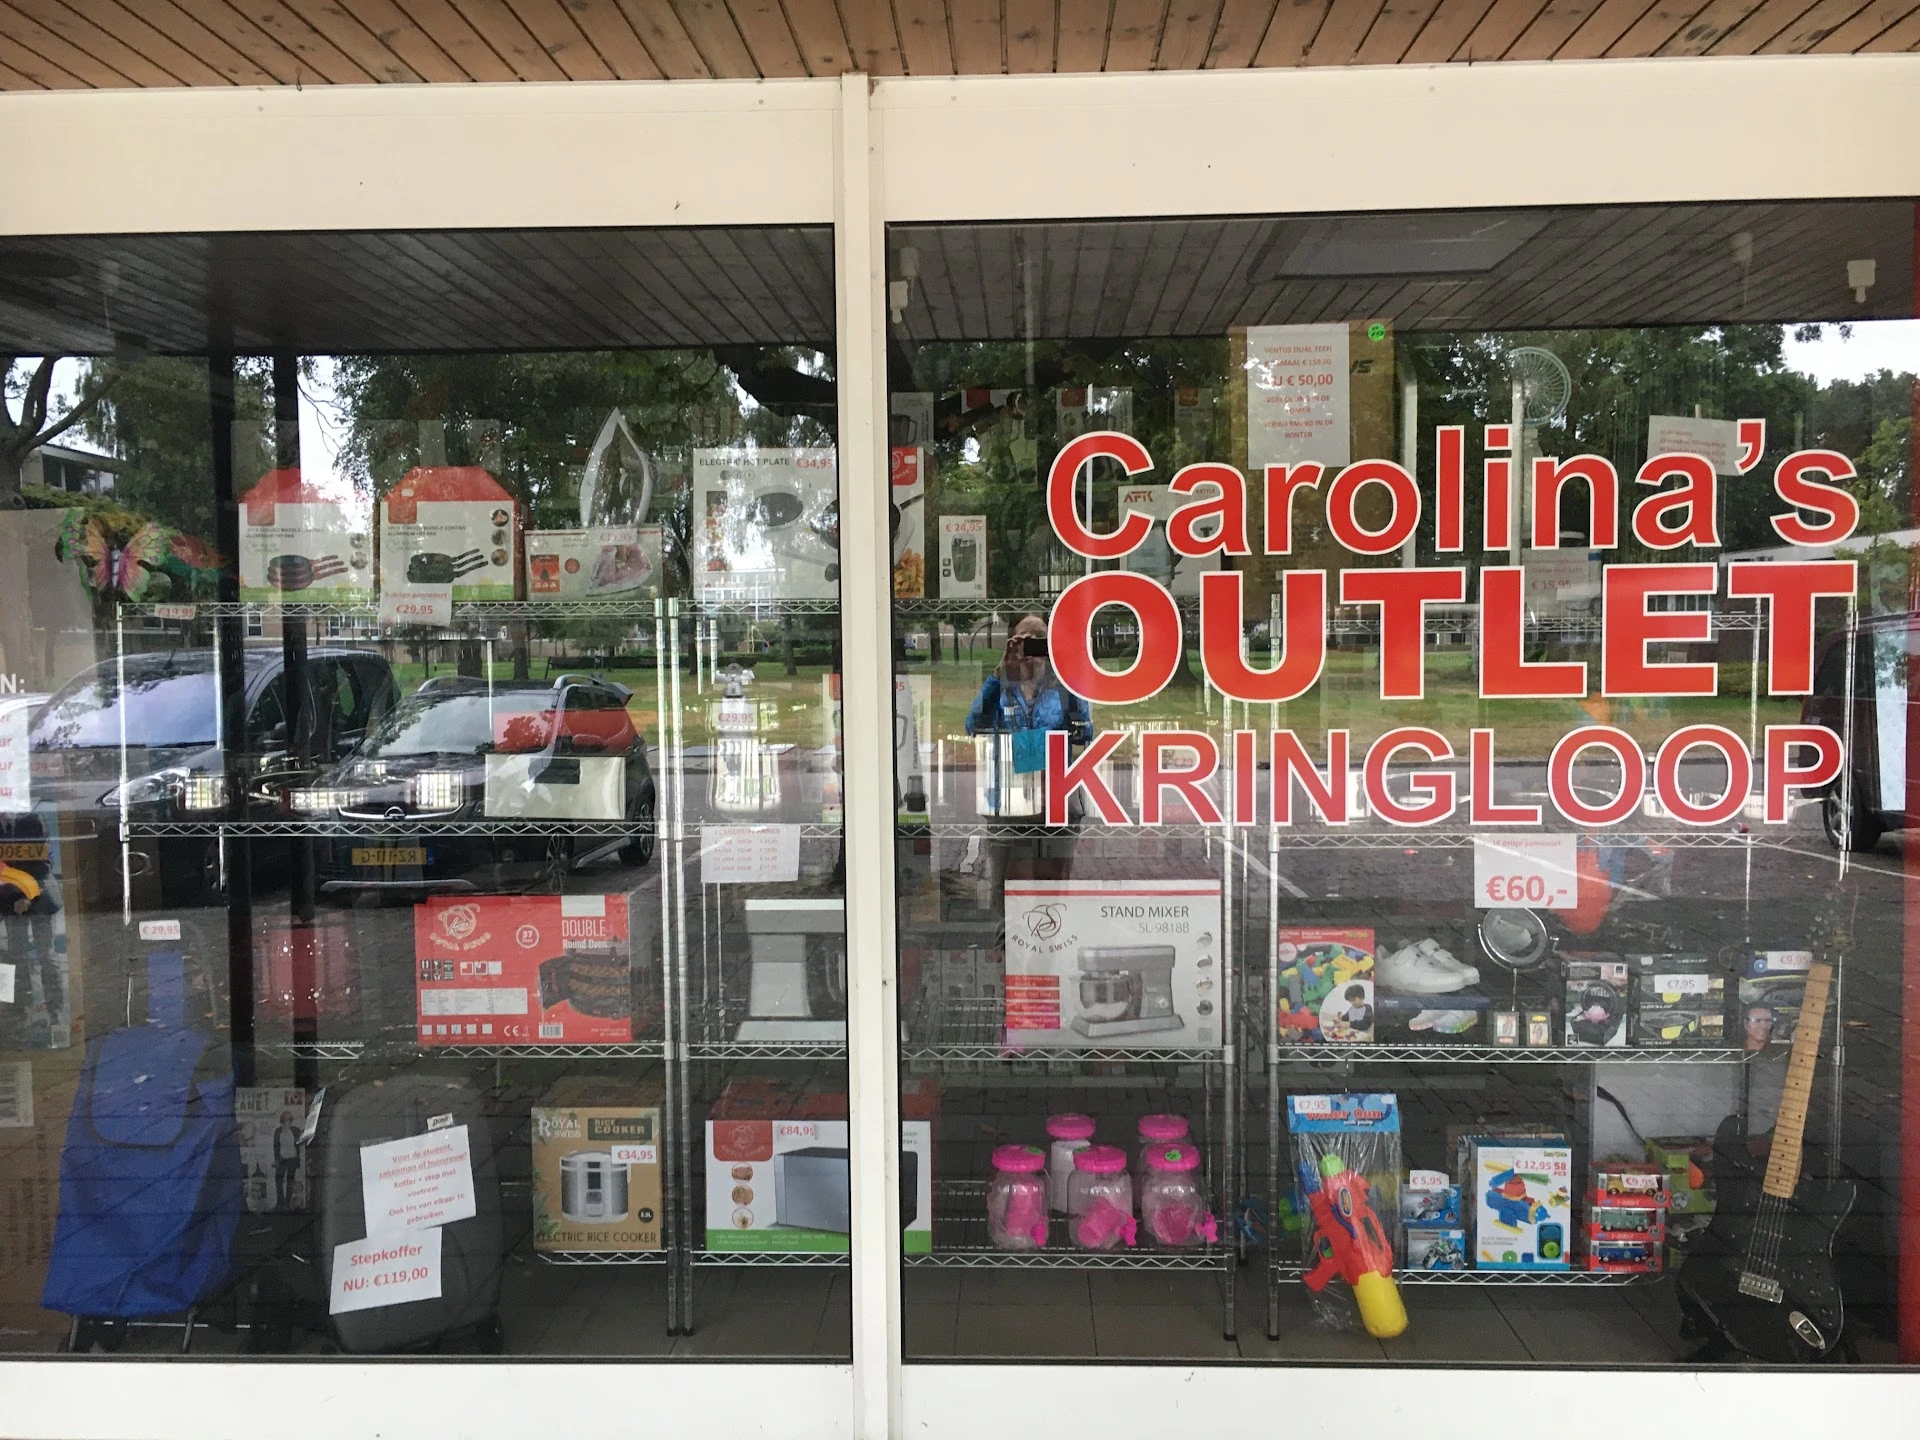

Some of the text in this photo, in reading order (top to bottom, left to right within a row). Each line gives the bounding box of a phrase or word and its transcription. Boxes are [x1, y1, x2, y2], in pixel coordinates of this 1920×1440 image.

[1287, 376, 1294, 386] €
[1299, 374, 1333, 387] 50,00
[946, 523, 981, 533] € 24,95
[1542, 580, 1572, 590] 19,95
[396, 605, 433, 615] €29,95
[1047, 561, 1859, 705] OUTLET
[717, 713, 754, 724] €29,95
[1044, 724, 1845, 828] KRINGLOOP
[1101, 906, 1189, 917] STAND MIXER
[152, 925, 178, 935] 29,95
[562, 920, 606, 937] DOUBLE
[1139, 923, 1189, 933] SL-9818B
[563, 939, 586, 949] Round
[1011, 934, 1078, 953] ROYAL SWISS
[1668, 980, 1695, 989] €7,95
[1299, 1102, 1325, 1110] €7,95
[1353, 1108, 1383, 1119] Gun
[595, 1126, 644, 1134] COOKER
[781, 1126, 815, 1136] €84,95
[413, 1150, 420, 1158] de
[618, 1150, 652, 1160] €34,95
[419, 1161, 426, 1169] of
[1515, 1160, 1551, 1170] € 12,95
[1554, 1162, 1566, 1170] 58
[394, 1179, 416, 1188] Koffer
[425, 1173, 440, 1181] step
[1412, 1177, 1442, 1186] € 5,95
[408, 1186, 438, 1197] voetrem
[587, 1233, 609, 1242] RICE
[614, 1232, 656, 1242] COOKER
[351, 1245, 423, 1267] Stepkoffer
[343, 1267, 428, 1292] NU: €119,00
